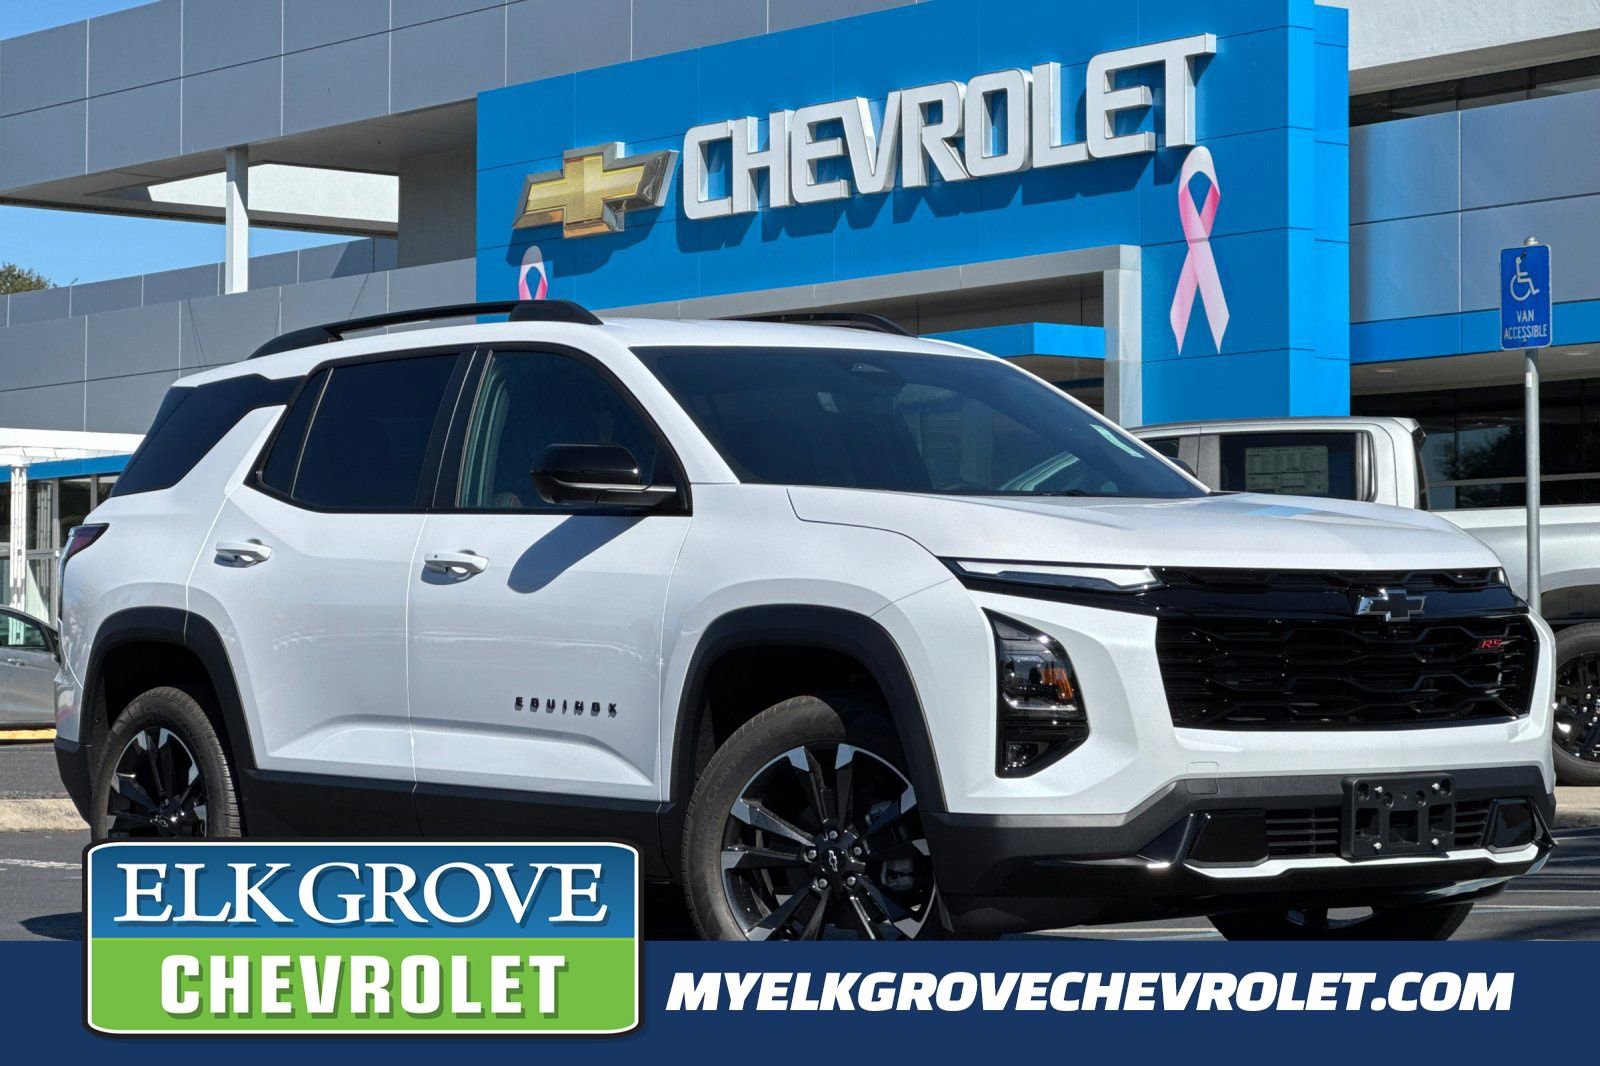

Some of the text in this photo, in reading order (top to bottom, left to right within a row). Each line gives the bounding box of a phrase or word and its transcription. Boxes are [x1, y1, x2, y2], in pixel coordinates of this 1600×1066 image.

[683, 33, 1217, 219] CHEVROLET
[1516, 309, 1535, 323] VAN
[1503, 324, 1548, 340] ACCESSIBLE
[1481, 639, 1504, 649] RS
[514, 696, 617, 715] EQUINOX
